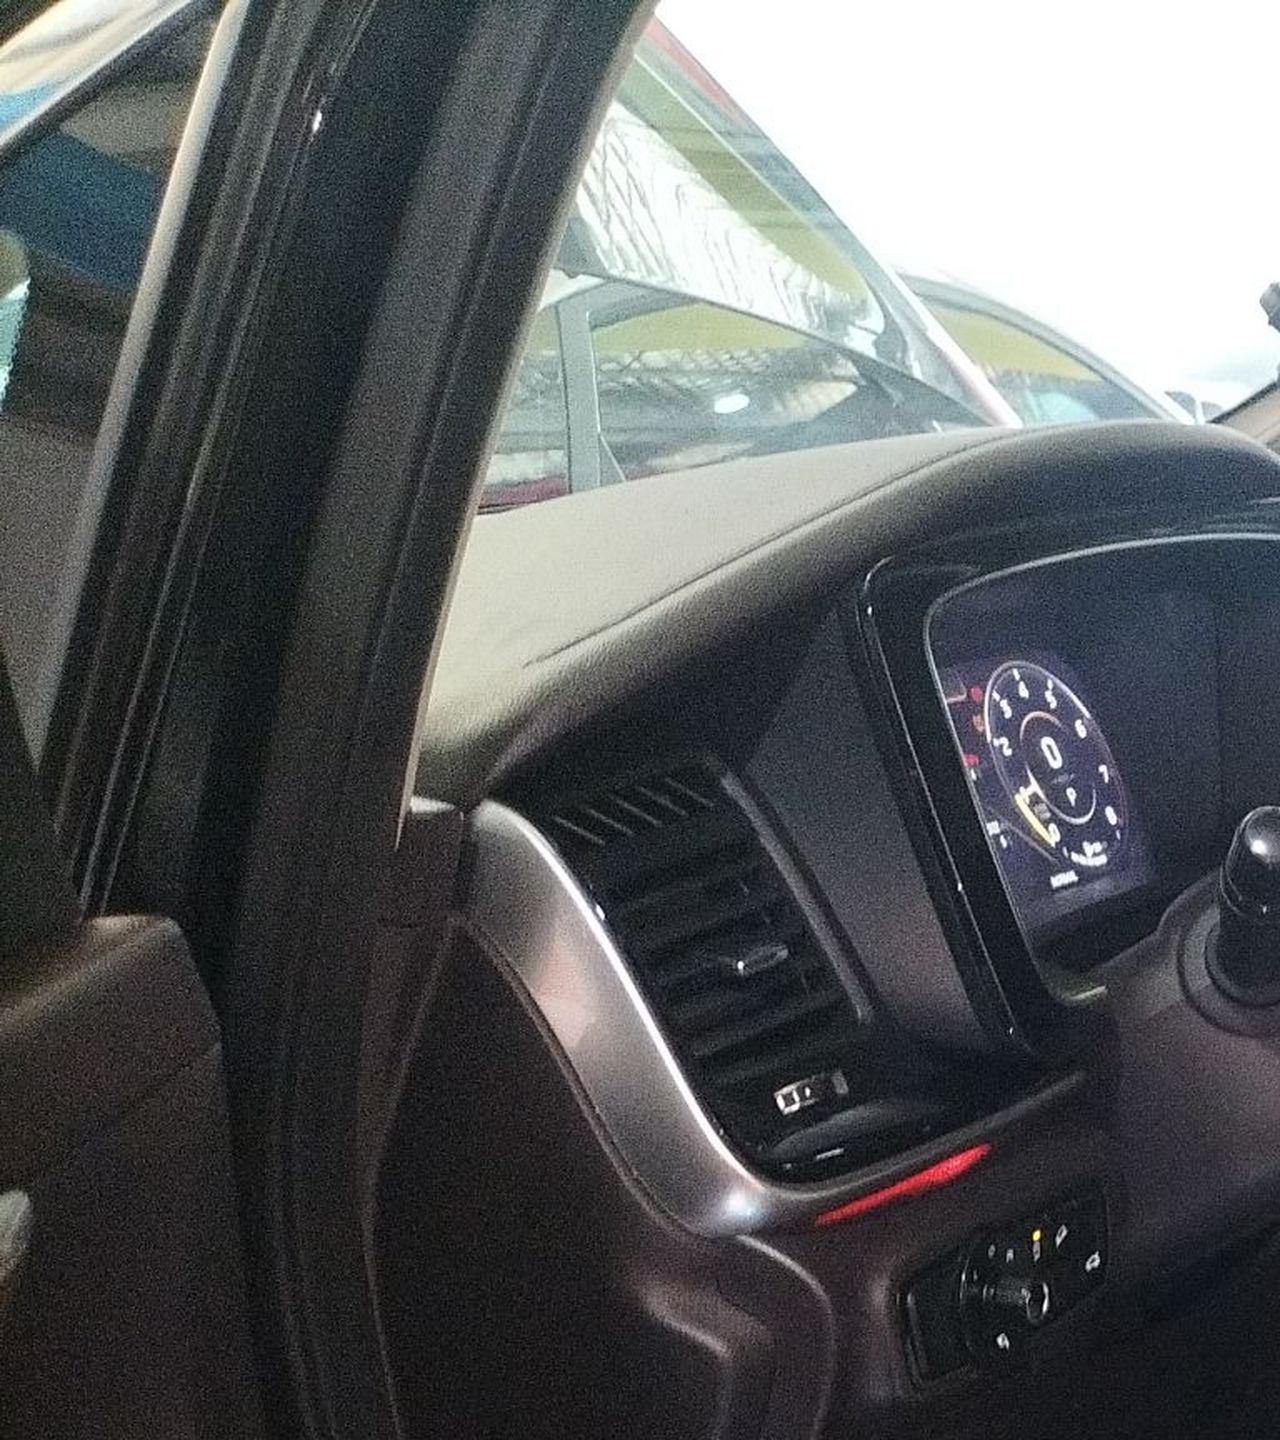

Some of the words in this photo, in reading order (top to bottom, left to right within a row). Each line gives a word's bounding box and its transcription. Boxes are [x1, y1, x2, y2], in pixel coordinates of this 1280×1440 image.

[1074, 719, 1087, 738] 6
[1000, 736, 1012, 757] 2
[1041, 736, 1063, 769] 0
[1098, 764, 1109, 783] 7
[1066, 787, 1077, 806] P
